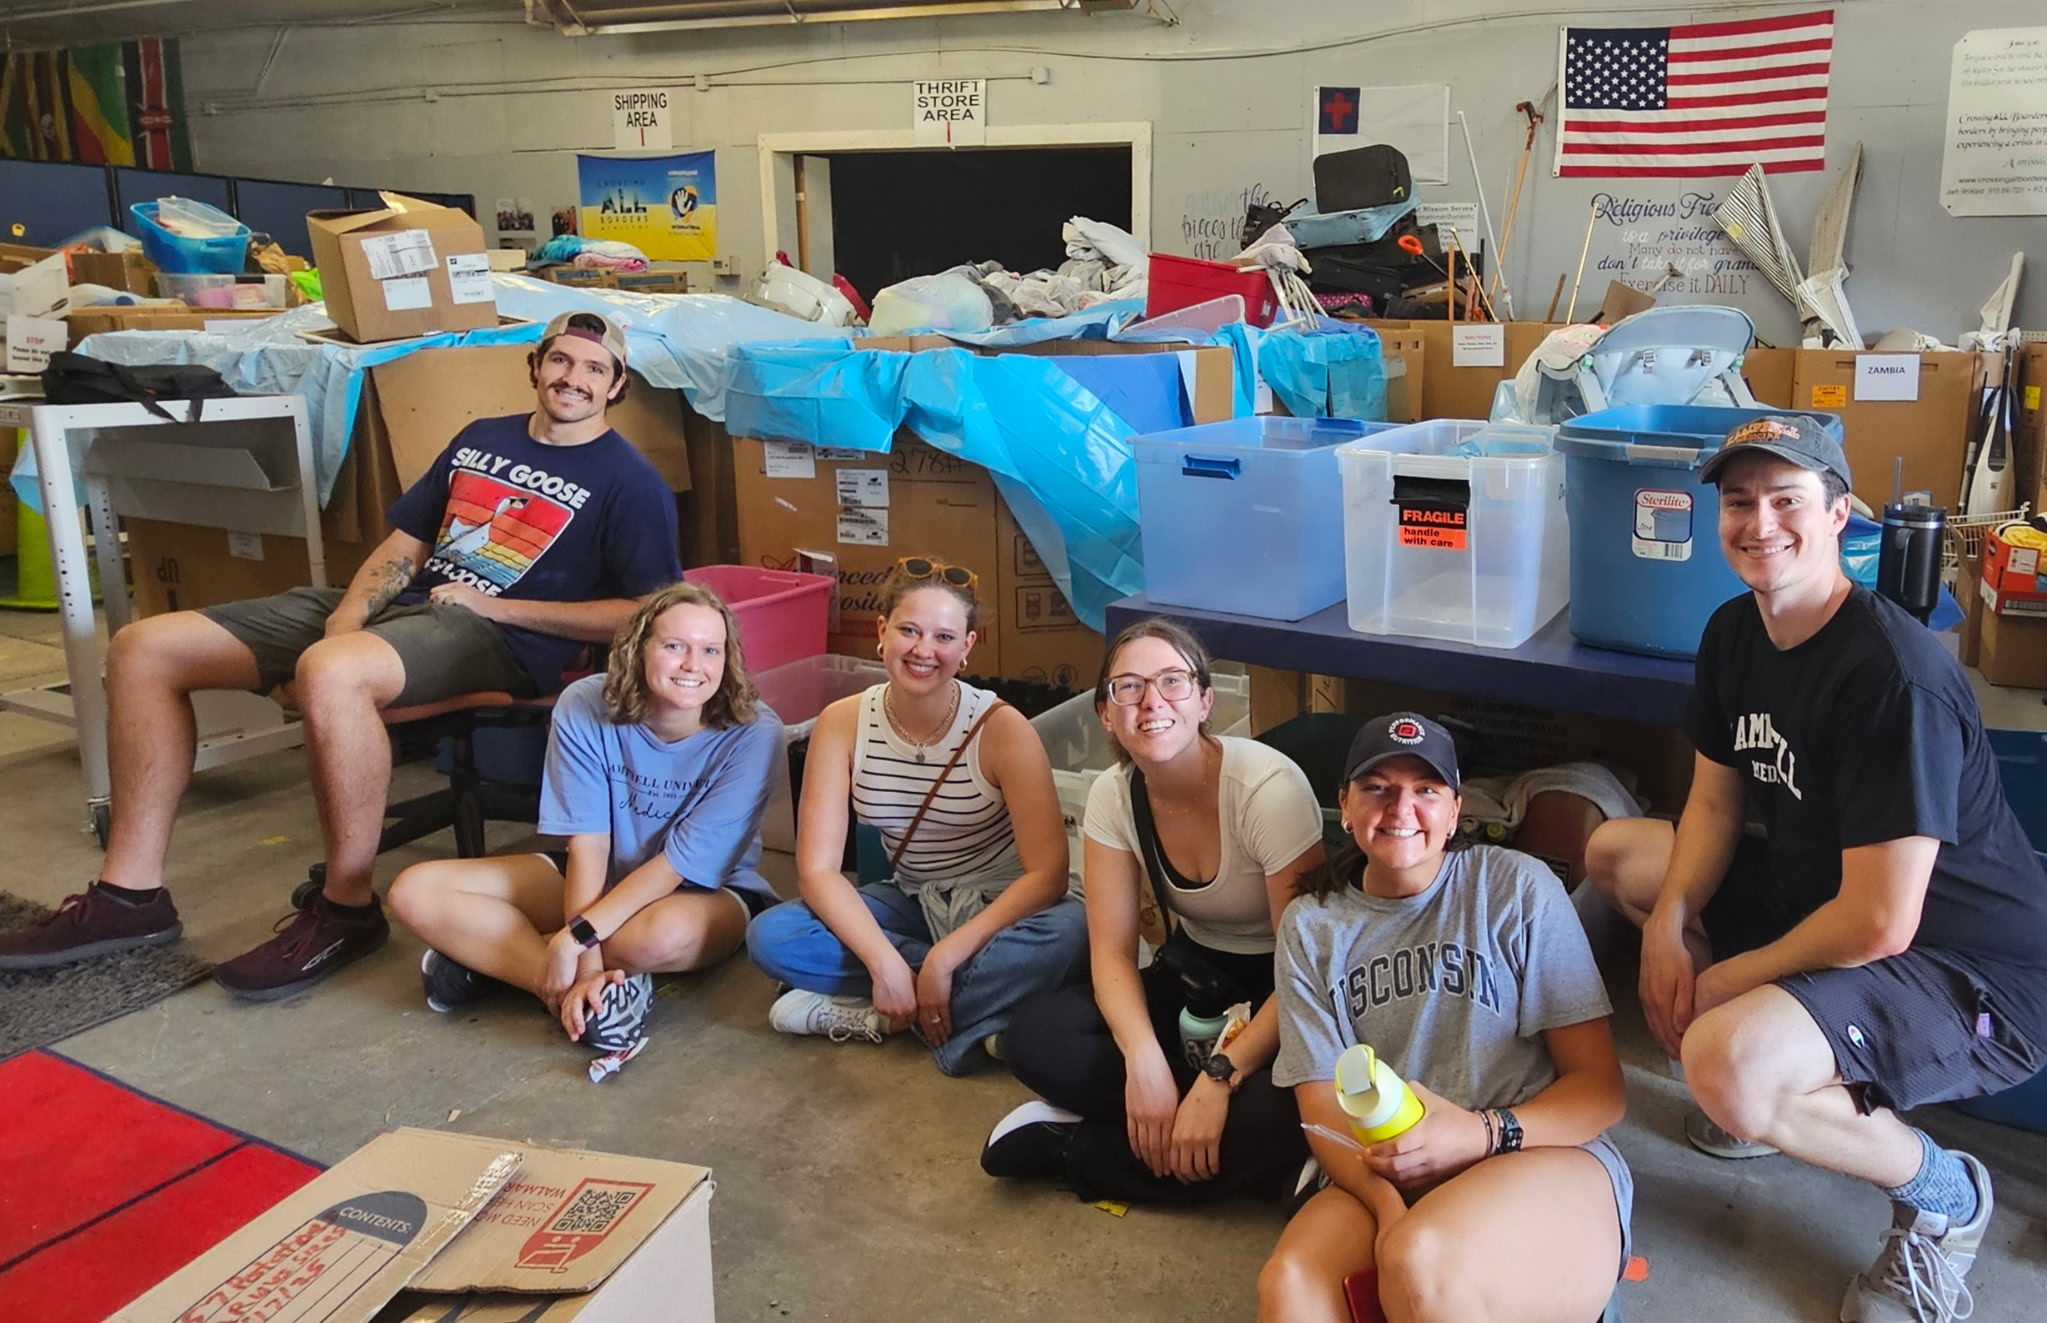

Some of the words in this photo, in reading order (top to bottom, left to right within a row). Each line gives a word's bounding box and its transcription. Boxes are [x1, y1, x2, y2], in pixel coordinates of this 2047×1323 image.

[915, 81, 980, 94] THRIFT
[615, 92, 667, 110] SHIPPING
[918, 94, 980, 108] STORE
[626, 111, 658, 127] AREA
[923, 109, 974, 121] AREA
[600, 187, 648, 214] ALL
[1239, 182, 1270, 215] the
[1591, 192, 1676, 227] Religious
[1680, 192, 1725, 220] Fre
[1181, 214, 1226, 245] pieces
[1656, 226, 1725, 246] privilege
[1628, 242, 1663, 257] Many
[1667, 242, 1681, 255] do
[1686, 243, 1706, 255] not
[1709, 243, 1740, 256] have
[1597, 254, 1639, 271] don't
[1689, 276, 1702, 294] it
[1705, 273, 1751, 295] DAILY
[1868, 366, 1906, 375] ZAMBIA
[451, 447, 512, 475] SILLY
[508, 464, 591, 510] GOOSE
[1641, 493, 1684, 507] Sterilite
[1403, 509, 1465, 525] FRAGILE
[1404, 527, 1440, 537] handle
[1404, 537, 1428, 546] with
[1430, 539, 1454, 548] care
[1751, 759, 1781, 784] MED
[1329, 941, 1501, 1026] ISCONSIN
[503, 1180, 567, 1200] WALMAR
[515, 1203, 555, 1214] SCAN
[338, 1205, 414, 1236] CONTENTS:
[474, 1211, 503, 1224] MO
[502, 1214, 543, 1228] NEED
